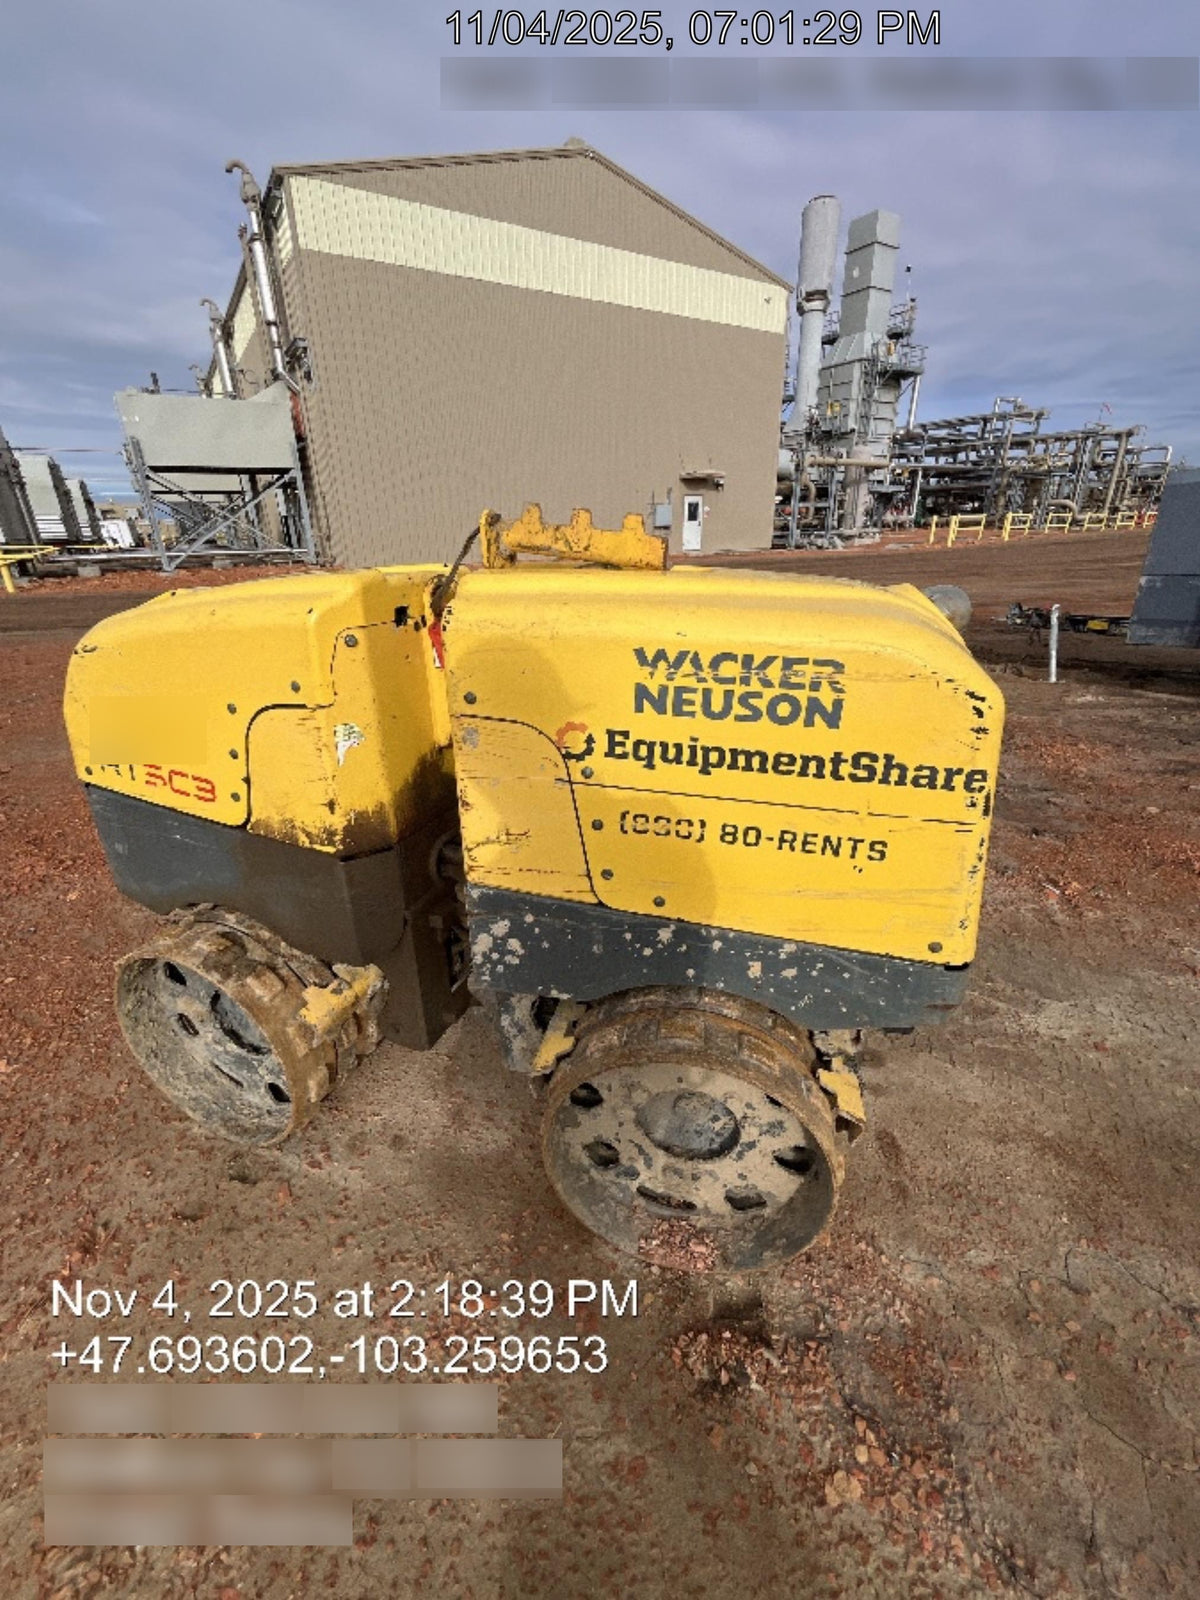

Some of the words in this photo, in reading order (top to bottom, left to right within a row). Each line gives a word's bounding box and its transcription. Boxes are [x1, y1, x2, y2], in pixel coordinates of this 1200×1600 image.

[632, 646, 846, 693] WACKER
[633, 683, 844, 729] NEUSON
[604, 729, 989, 793] EquipmentShare
[719, 823, 889, 862] 80-RENTS
